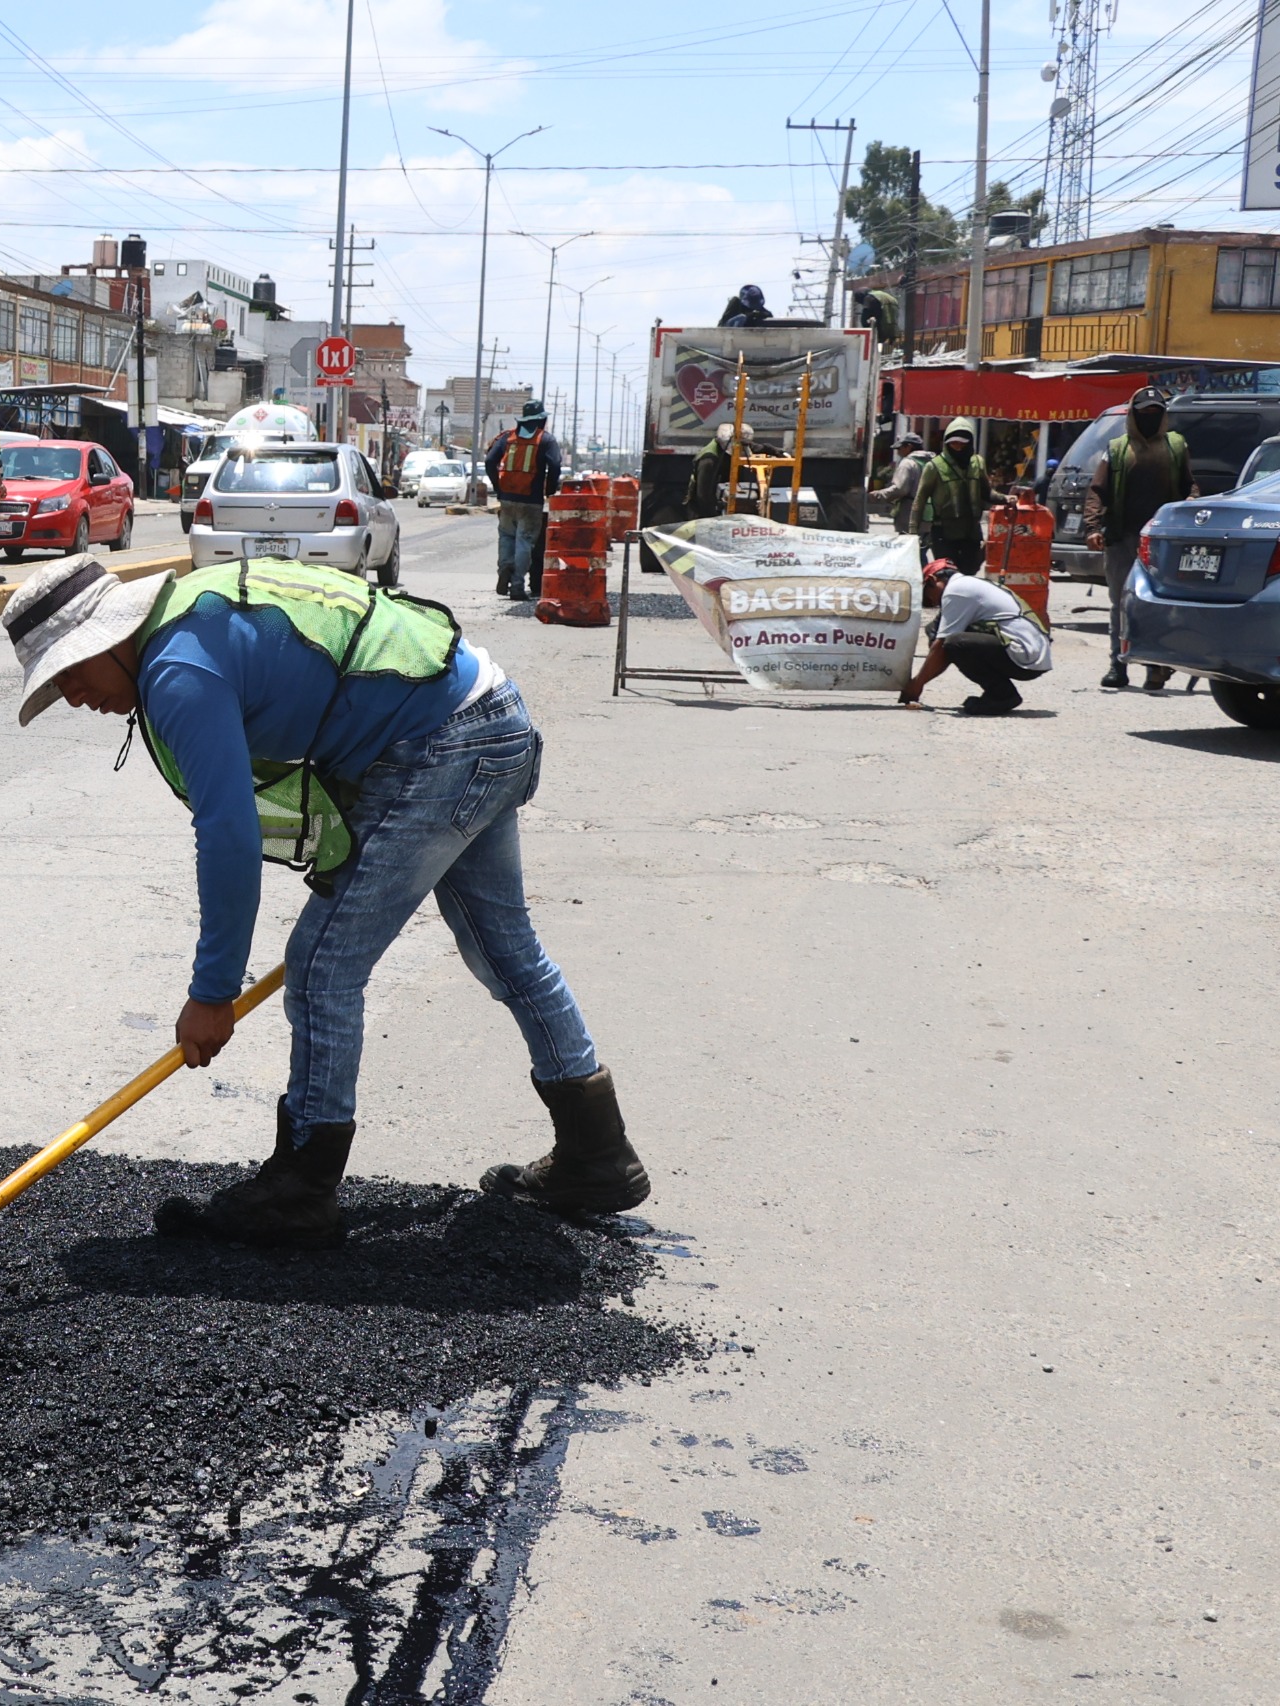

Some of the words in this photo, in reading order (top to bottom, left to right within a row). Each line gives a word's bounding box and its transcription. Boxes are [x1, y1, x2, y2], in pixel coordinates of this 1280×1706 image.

[322, 346, 349, 367] 1x1
[749, 403, 780, 413] Amor
[792, 400, 832, 411] Pebla
[755, 559, 801, 568] PUEBLA
[730, 582, 900, 615] BACHETÓN
[756, 630, 812, 646] Amor
[814, 632, 827, 644] a
[833, 629, 896, 651] Puebla
[763, 661, 780, 672] del
[783, 661, 838, 672] Gobierno
[841, 661, 859, 672] del
